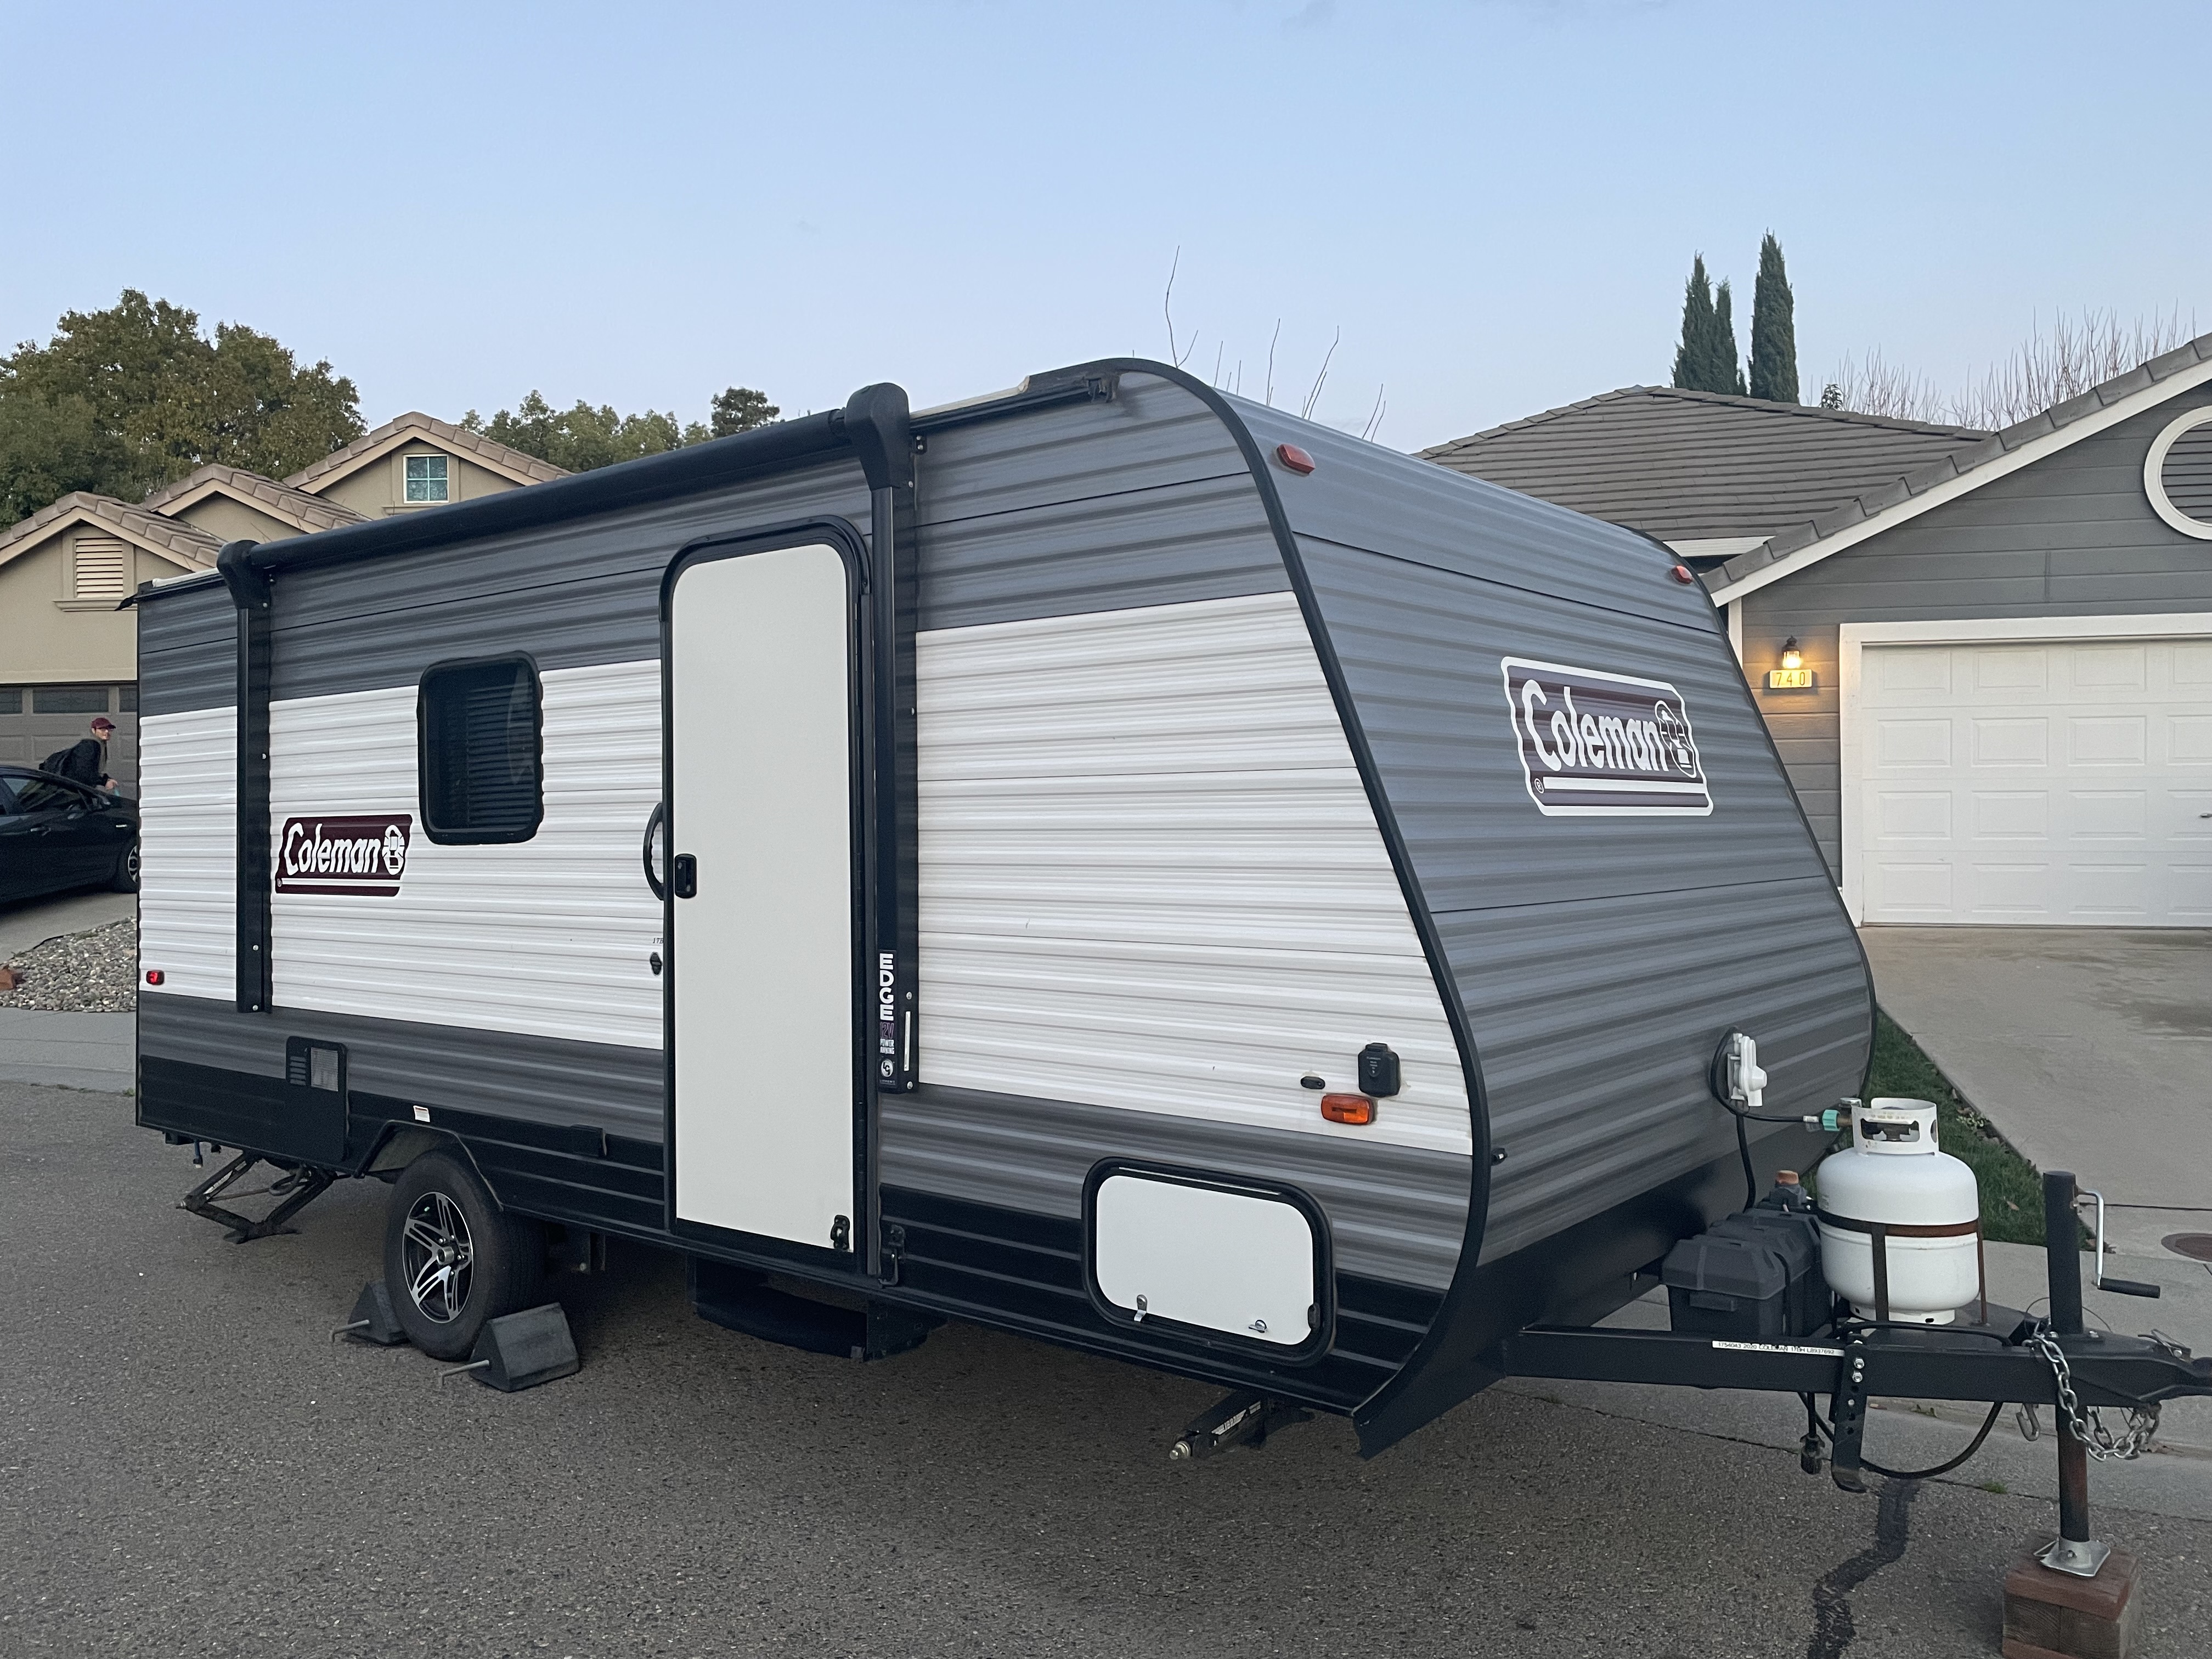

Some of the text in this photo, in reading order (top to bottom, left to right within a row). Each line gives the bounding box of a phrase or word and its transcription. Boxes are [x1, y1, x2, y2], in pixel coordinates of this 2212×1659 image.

[1776, 672, 1805, 687] 740
[1521, 679, 1669, 772] Coleman
[284, 822, 381, 876] Coleman
[879, 953, 894, 1021] EDGE
[880, 1022, 894, 1039] 12V
